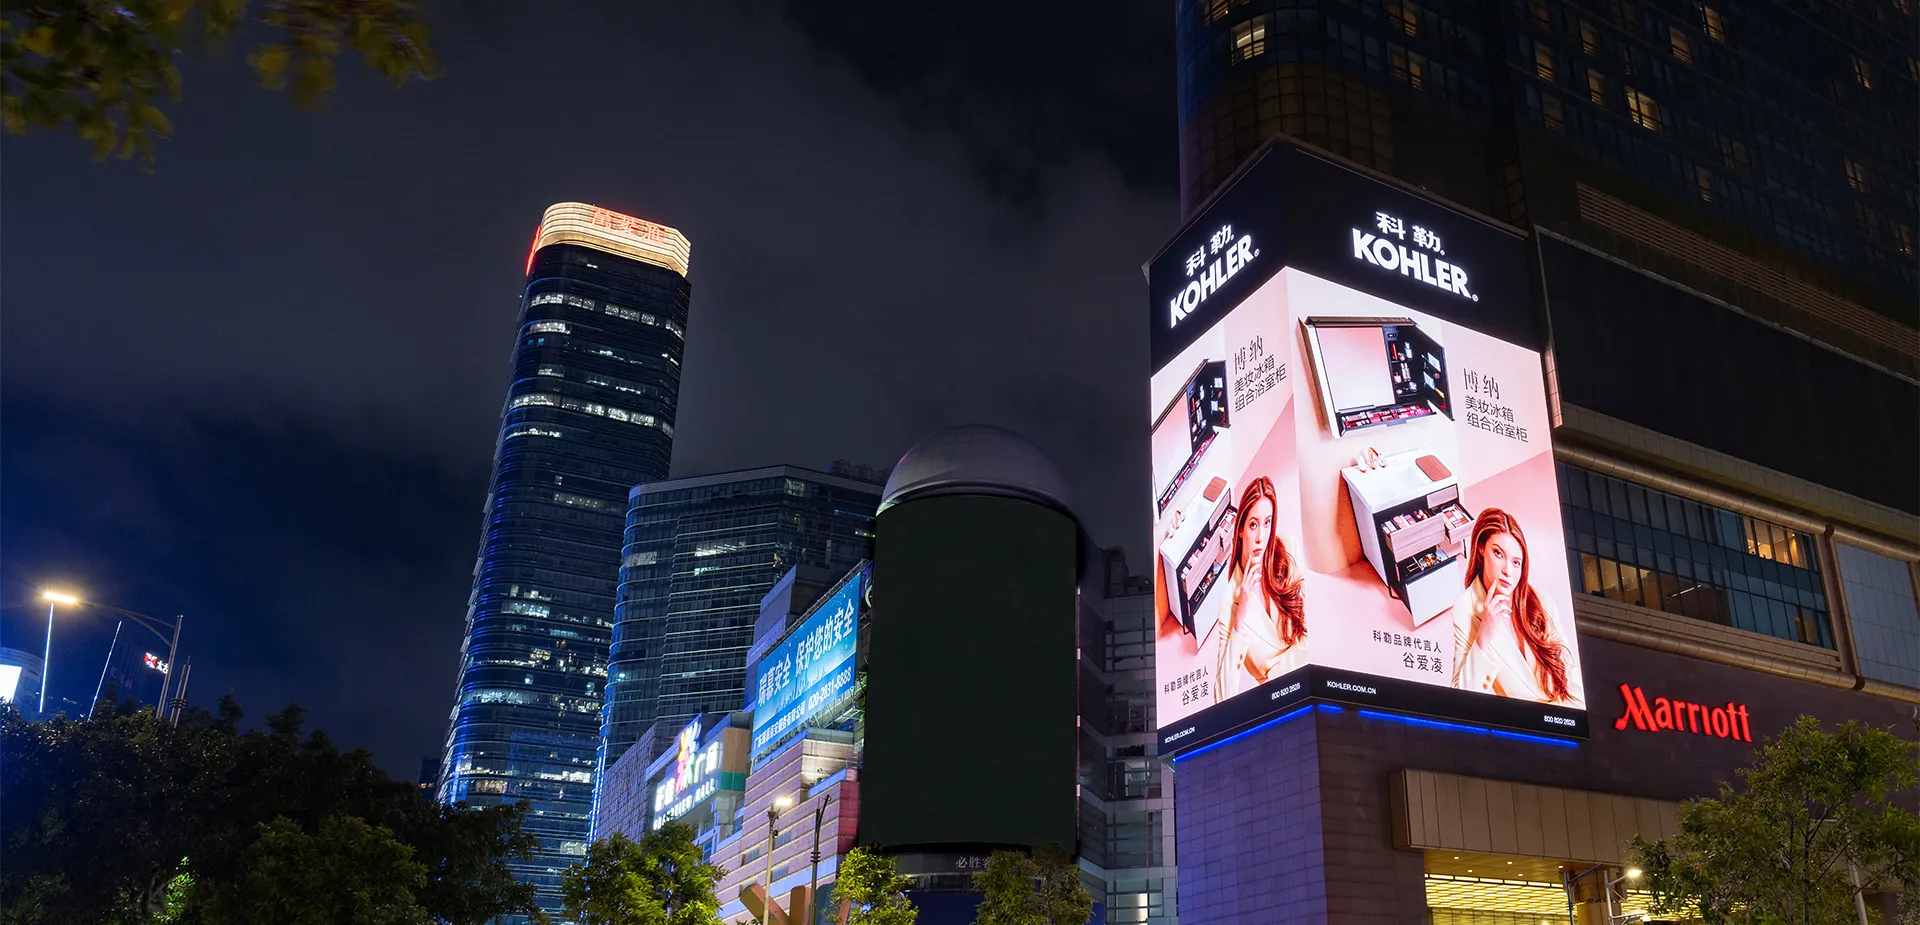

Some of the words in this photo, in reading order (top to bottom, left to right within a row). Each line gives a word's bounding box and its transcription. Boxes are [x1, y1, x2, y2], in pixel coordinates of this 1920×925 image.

[1376, 212, 1442, 253] 科勒
[1186, 225, 1232, 277] 科勒
[1353, 228, 1473, 298] KOHLER
[1171, 235, 1255, 328] KOHLER
[1235, 336, 1262, 372] 博纳
[1235, 355, 1278, 396] 美妆冰箱
[1235, 364, 1286, 412] 组合浴室柜
[1464, 368, 1499, 399] 博纳
[1466, 396, 1513, 422] 美妆冰箱
[1467, 412, 1528, 442] 组合浴室柜
[796, 598, 855, 679] 保护您的安全
[1373, 630, 1441, 653] 科勒品牌代言人
[1164, 665, 1208, 693] 科勒品牌代言人
[1403, 652, 1443, 673] 谷爱凌
[1183, 682, 1208, 705] 谷爱凌
[1327, 681, 1376, 694] KOHLER.COM.CN
[1615, 684, 1752, 742] Marriott
[1165, 727, 1195, 743] KOHLER.COM.CN
